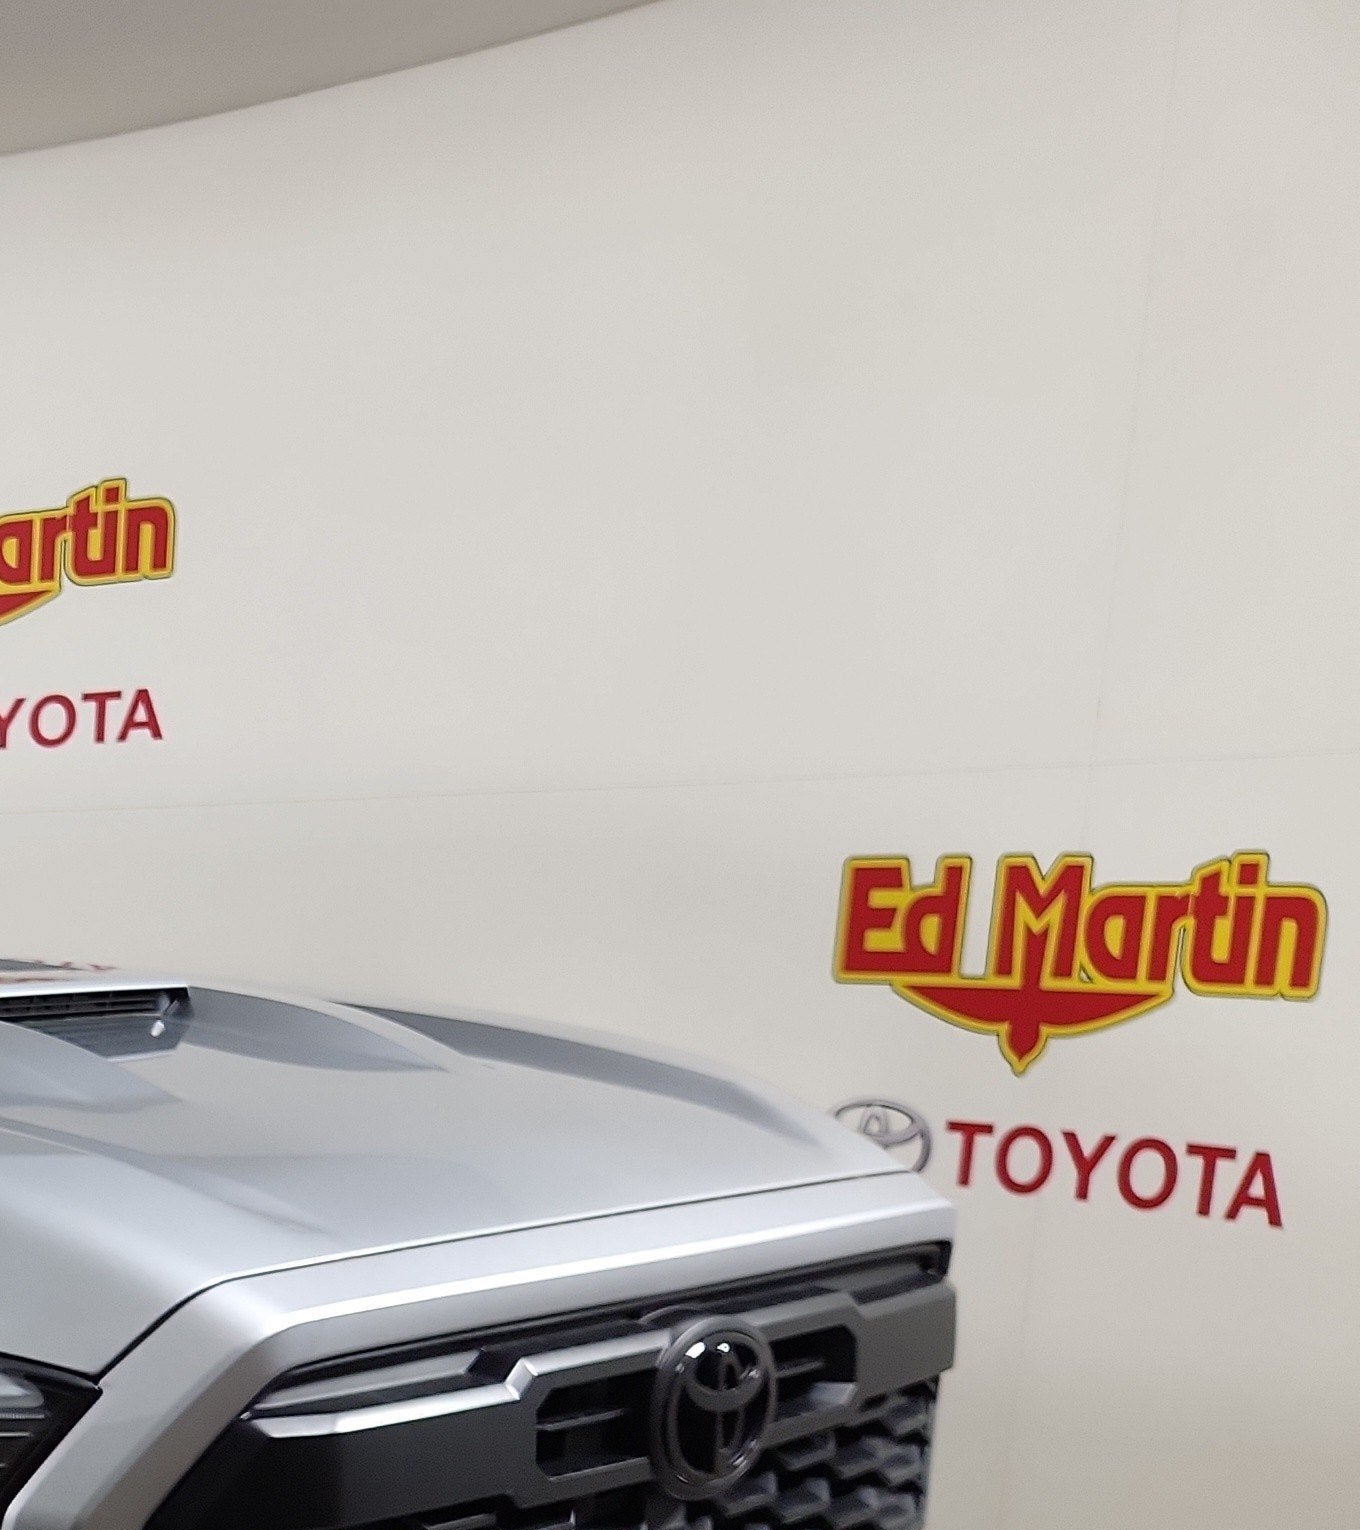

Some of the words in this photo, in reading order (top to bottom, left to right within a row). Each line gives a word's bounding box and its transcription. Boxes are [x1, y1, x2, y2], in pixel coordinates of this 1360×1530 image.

[838, 861, 967, 977] Ed
[991, 857, 1324, 993] Martin
[946, 1119, 1284, 1230] TOYOTA
